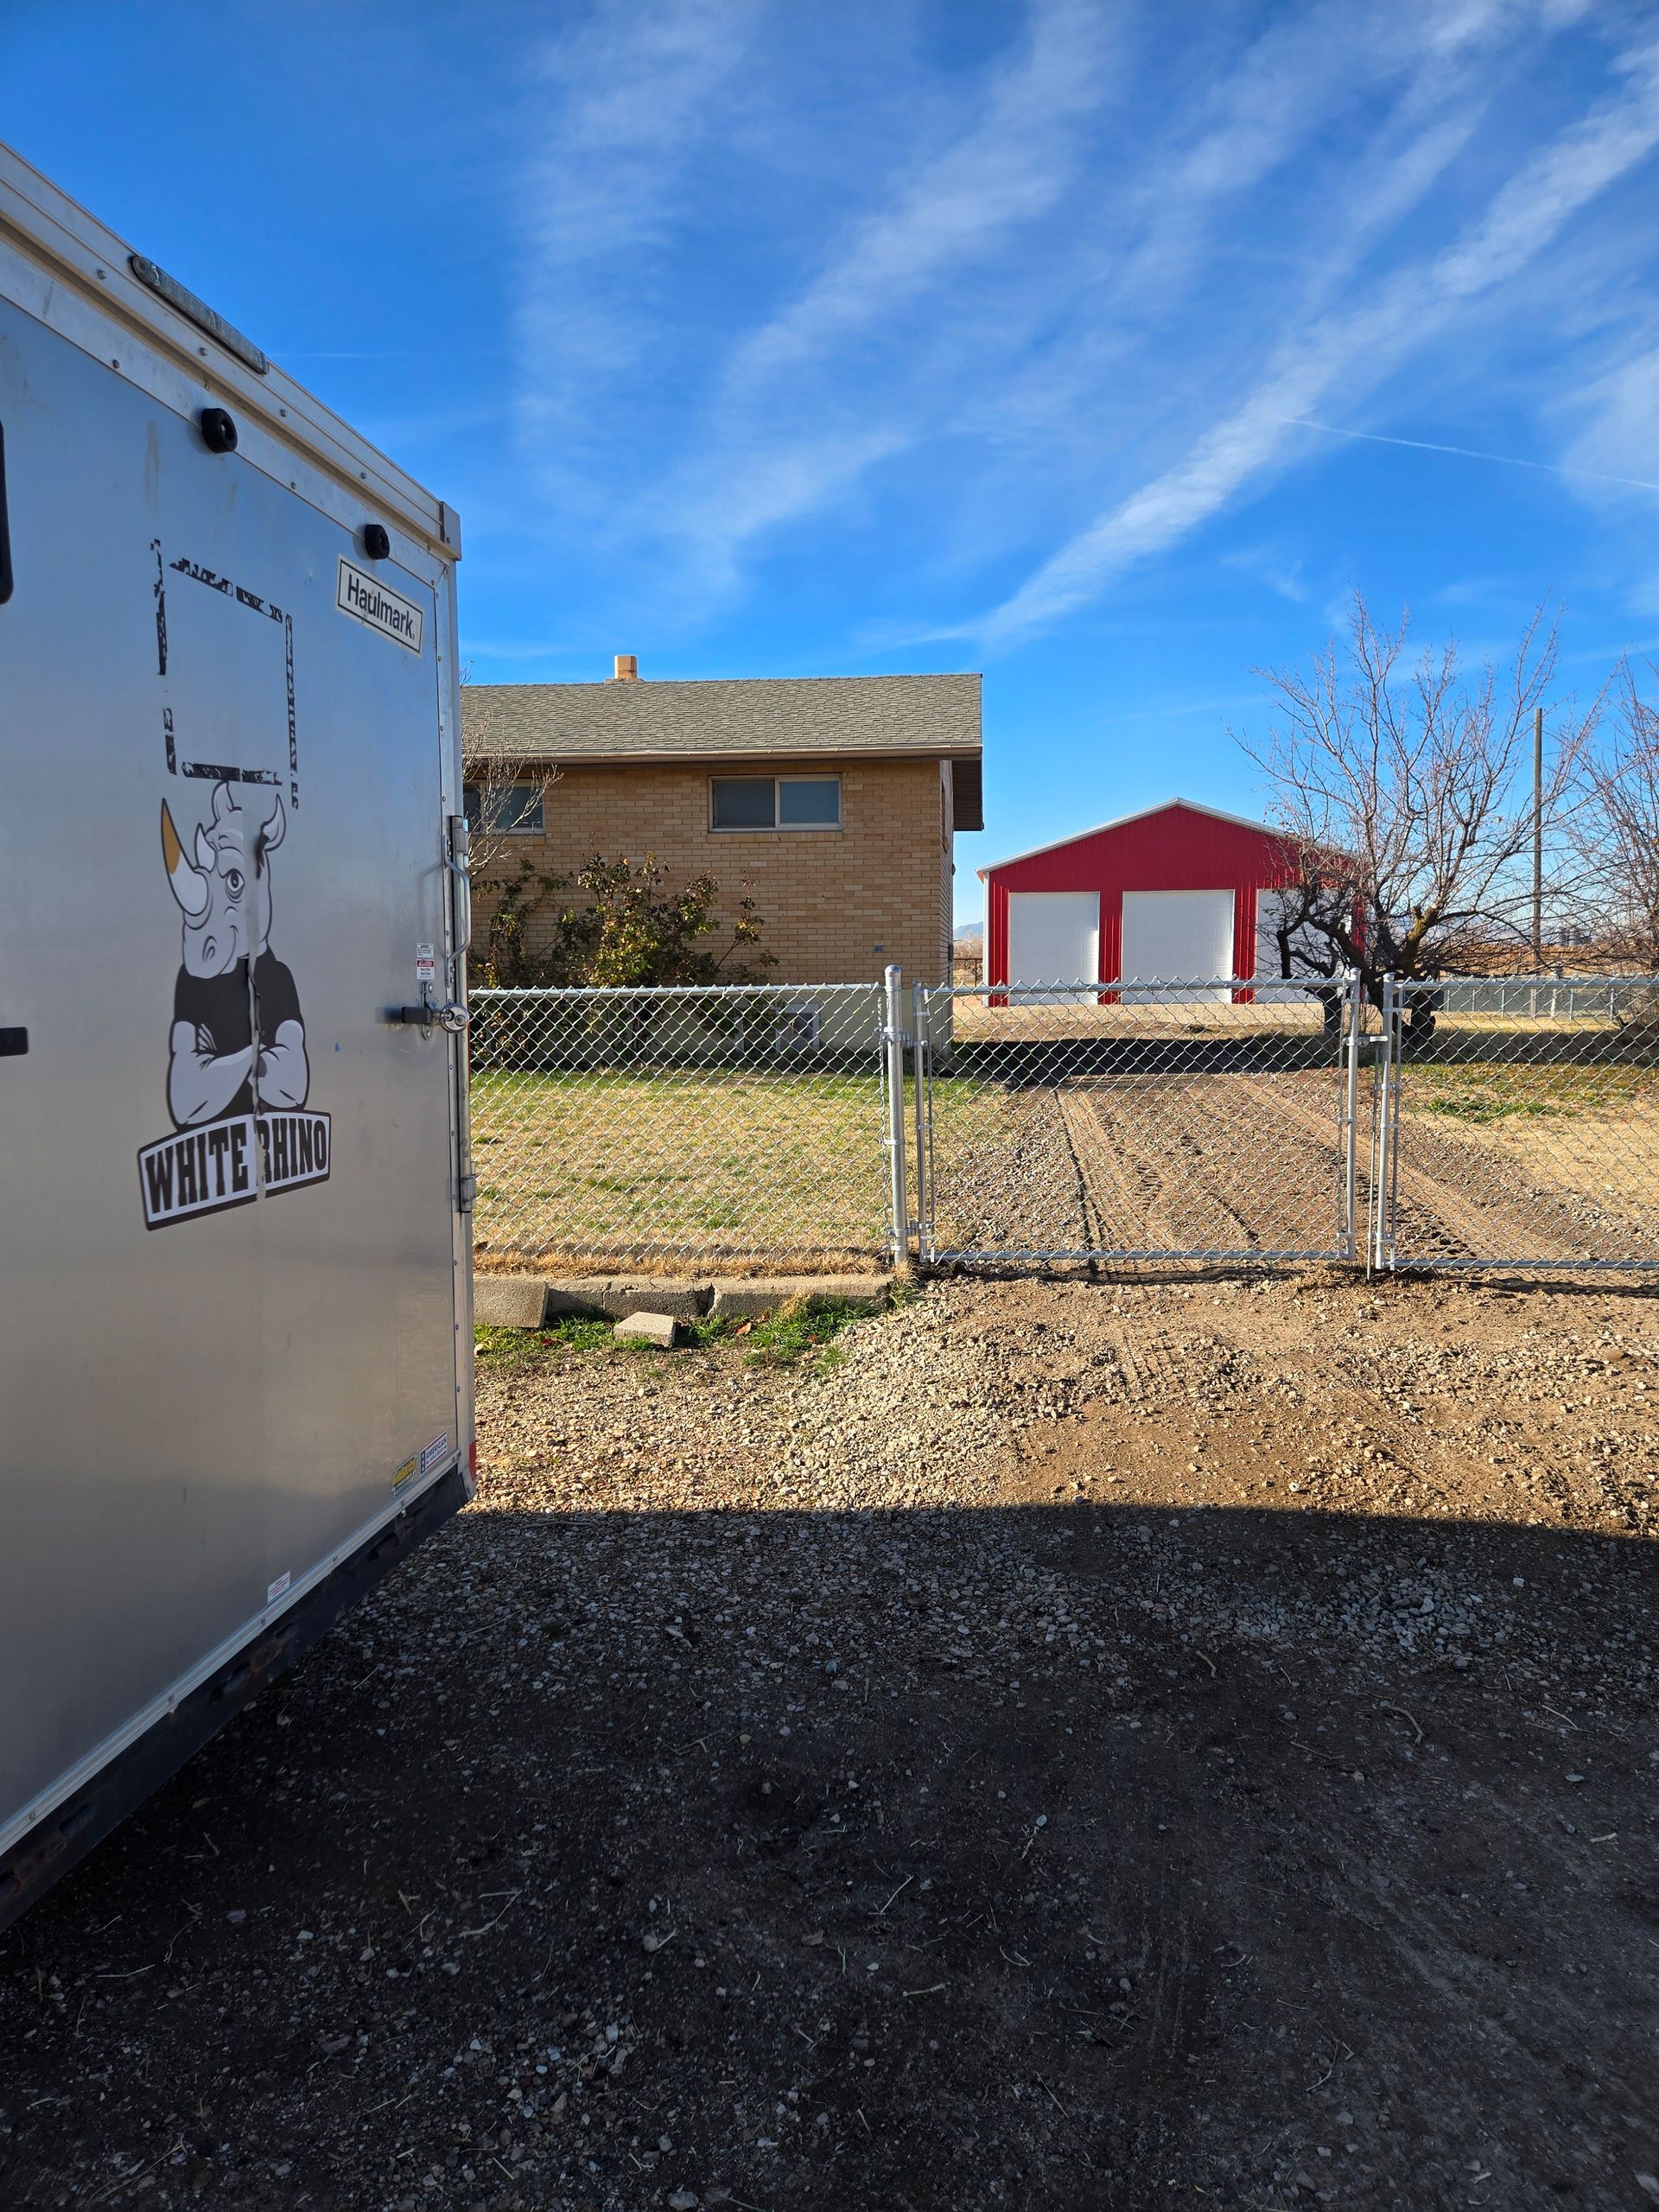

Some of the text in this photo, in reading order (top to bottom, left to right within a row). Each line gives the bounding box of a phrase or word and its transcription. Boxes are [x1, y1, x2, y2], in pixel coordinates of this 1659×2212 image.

[347, 573, 414, 639] Haulmark
[145, 1122, 249, 1214] WHITE
[427, 1437, 447, 1459] AMERICAN
